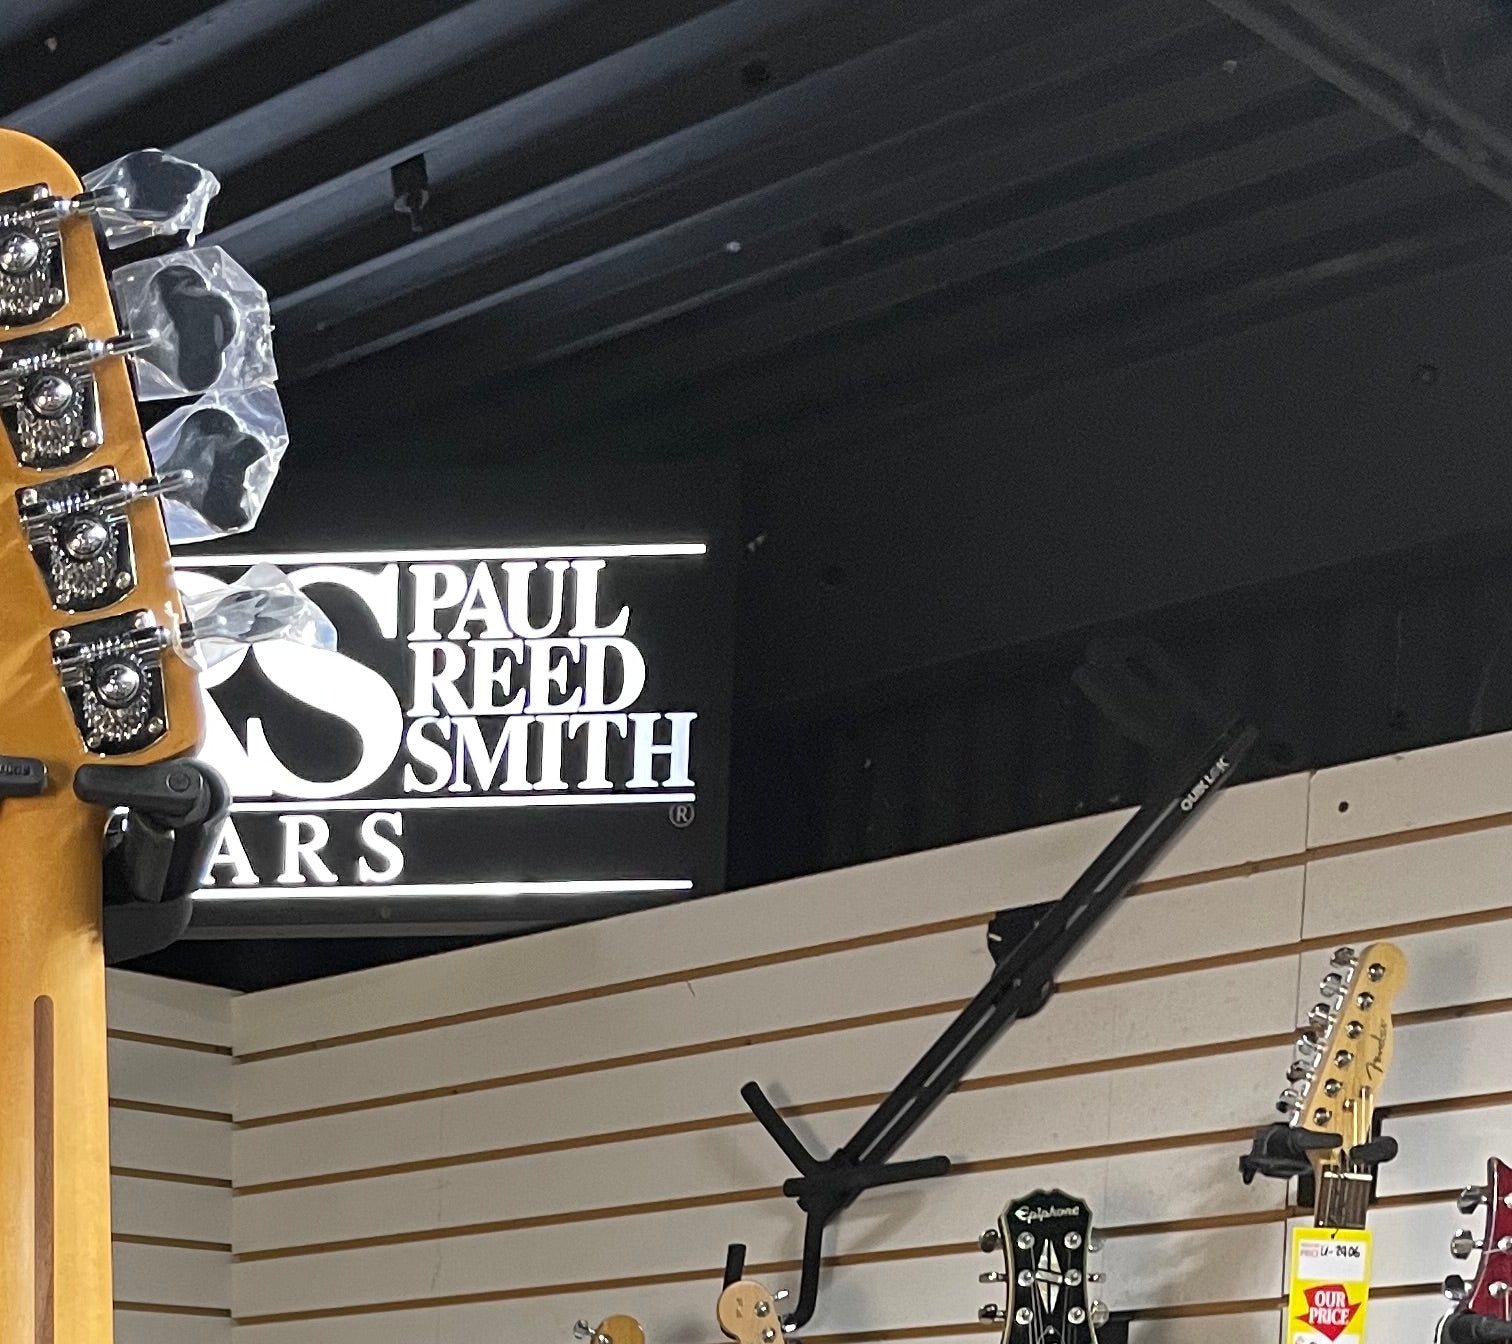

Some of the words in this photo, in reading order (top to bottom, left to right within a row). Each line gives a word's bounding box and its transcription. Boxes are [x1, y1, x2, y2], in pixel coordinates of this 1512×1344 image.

[406, 558, 631, 641] PAUL
[406, 637, 647, 717] REED
[402, 711, 699, 793] SMITH
[1014, 1205, 1080, 1225] Epiphone
[1309, 1307, 1349, 1325] PRICE
[1314, 1290, 1346, 1307] OUR
